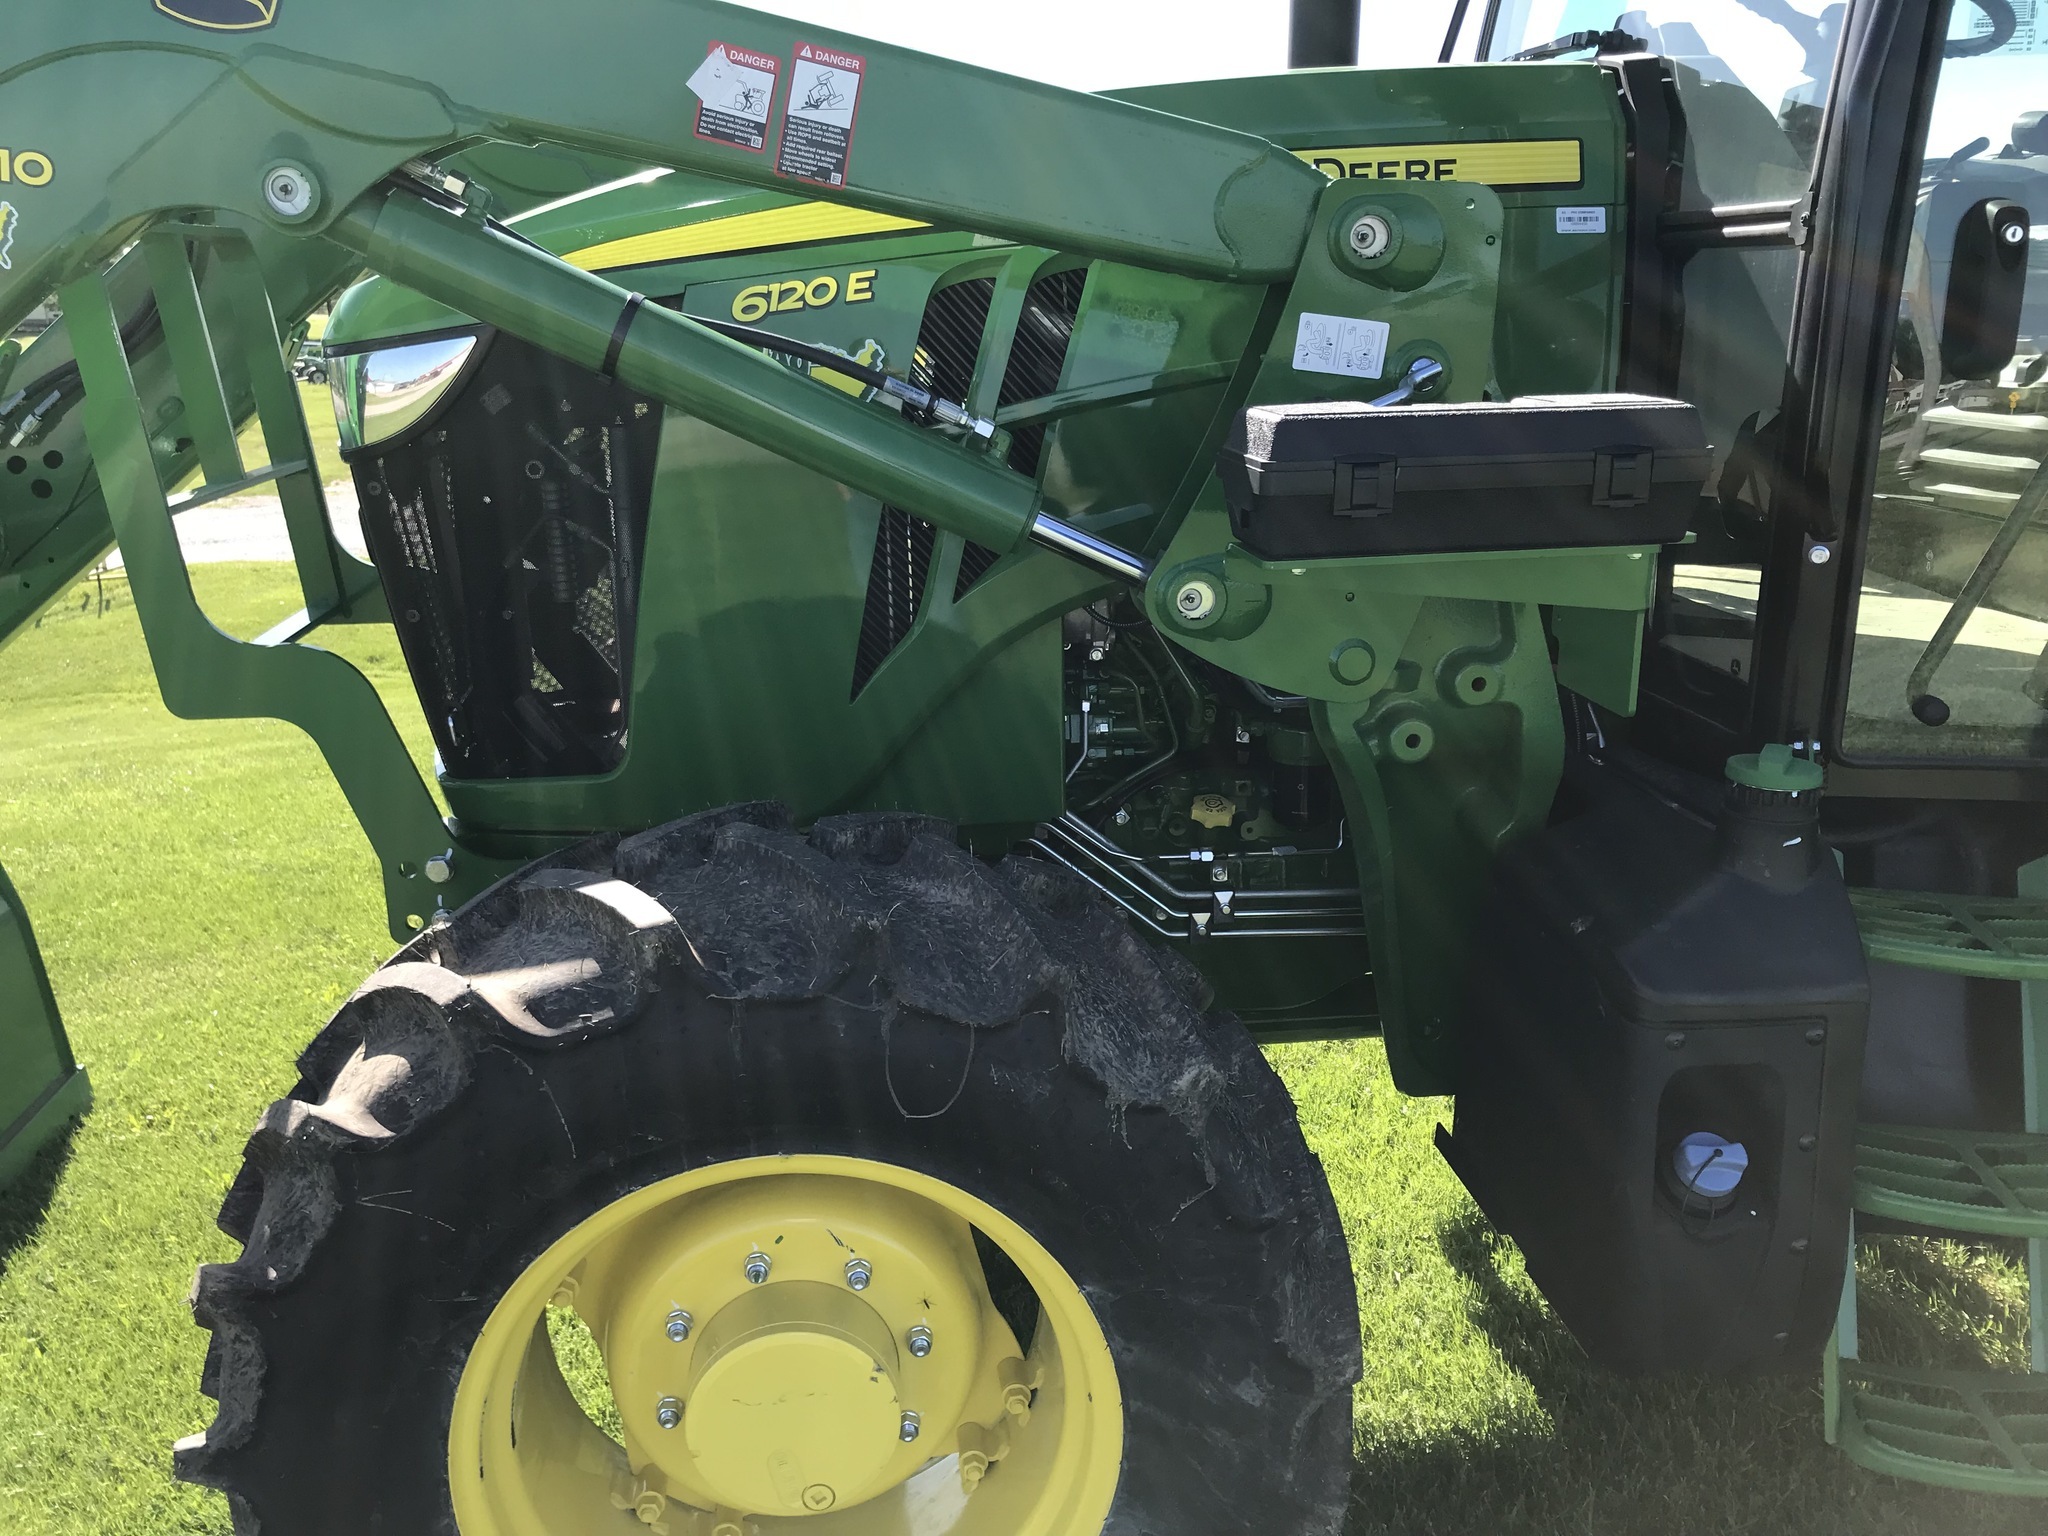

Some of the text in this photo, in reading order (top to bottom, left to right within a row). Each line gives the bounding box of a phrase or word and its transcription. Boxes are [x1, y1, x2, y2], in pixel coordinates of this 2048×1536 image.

[730, 50, 775, 70] DANGER
[816, 50, 860, 70] DANGER
[716, 112, 734, 121] serious
[735, 116, 749, 126] injury
[789, 116, 807, 125] Serious
[808, 121, 821, 129] injury
[716, 126, 734, 134] contact
[824, 131, 845, 140] rollovers.
[796, 144, 816, 152] required
[784, 154, 817, 165] recommended
[798, 150, 814, 158] wheels
